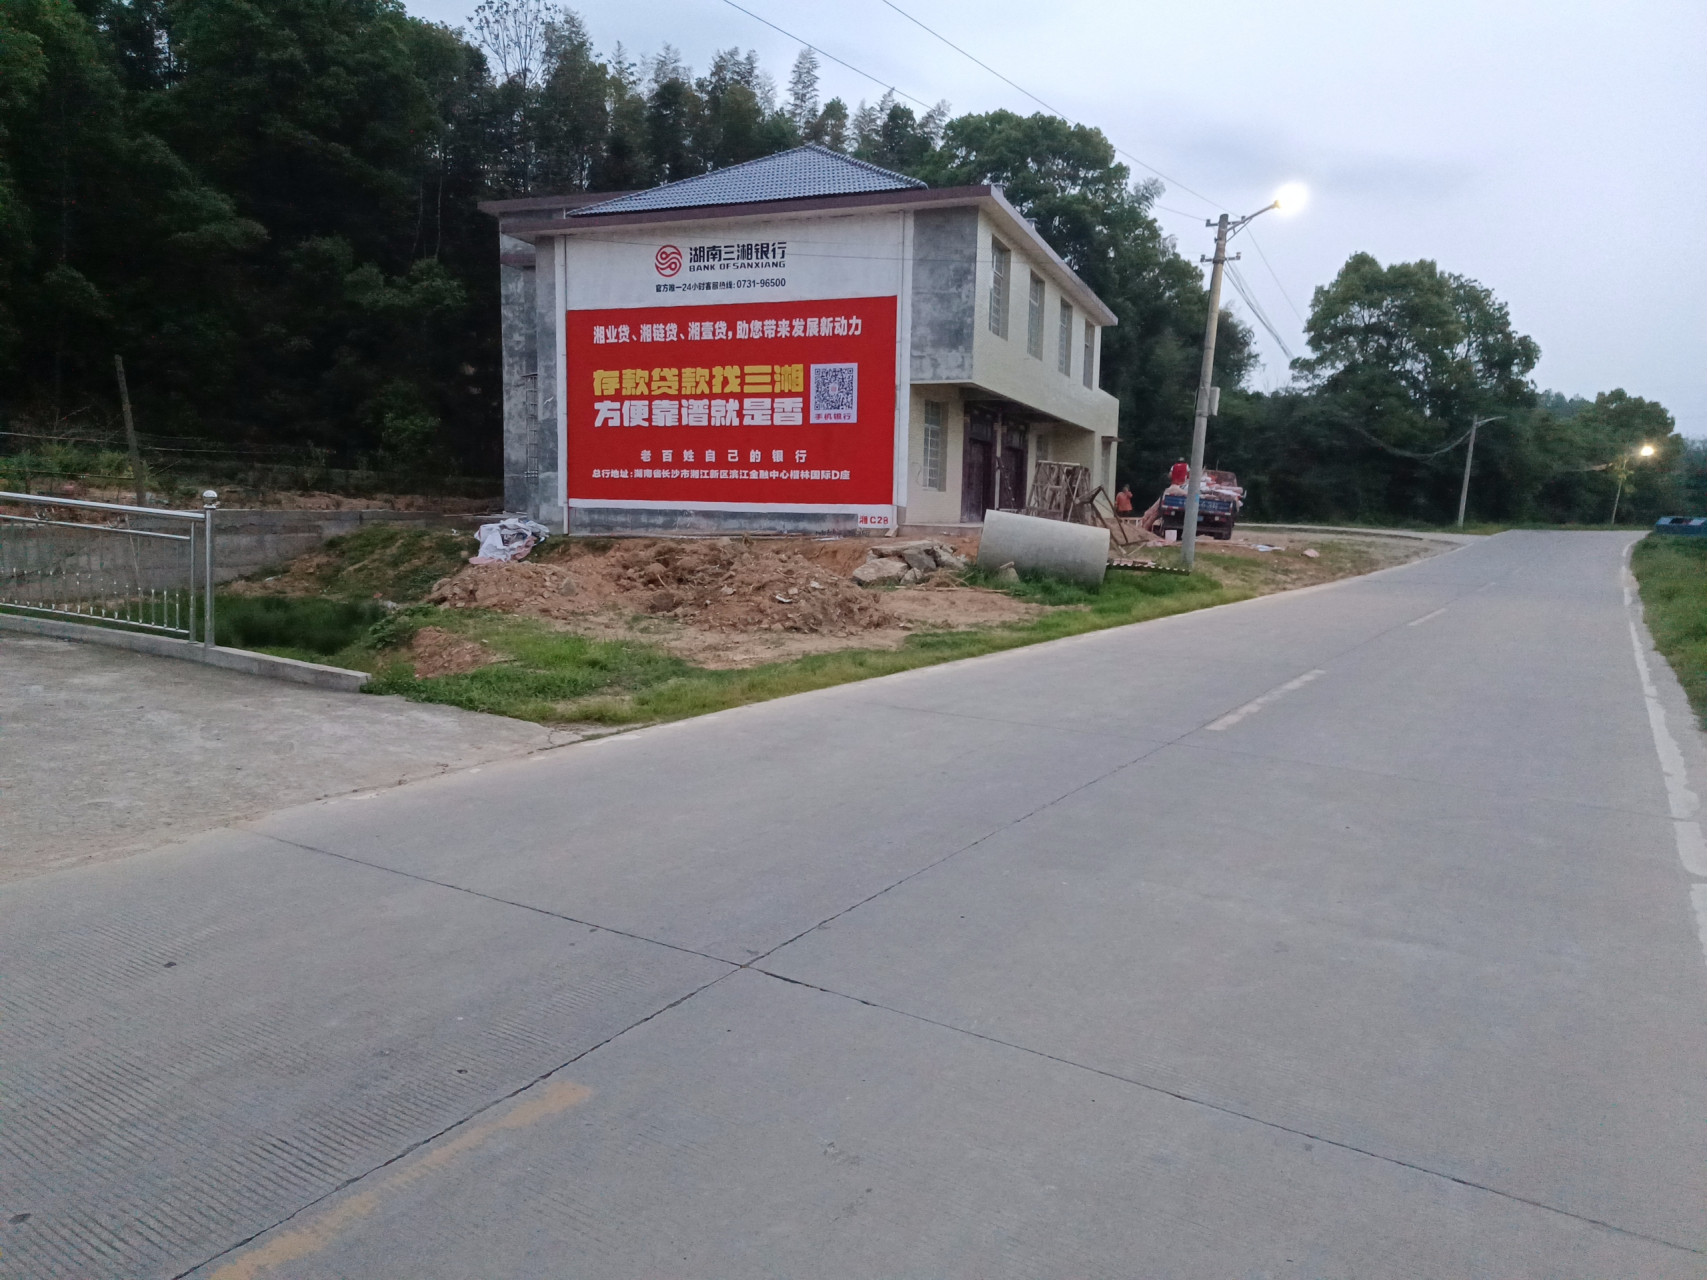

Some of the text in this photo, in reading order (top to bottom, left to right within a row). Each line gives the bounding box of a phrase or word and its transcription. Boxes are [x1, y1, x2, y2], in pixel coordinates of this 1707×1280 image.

[689, 242, 787, 263] 湖南三湘银行
[689, 264, 716, 272] BANK
[593, 364, 804, 395] 存款贷款找三湘
[594, 397, 803, 427] 方便靠谱就是香
[815, 412, 852, 421] 手机银行
[640, 449, 808, 463] 老百姓自己的银行
